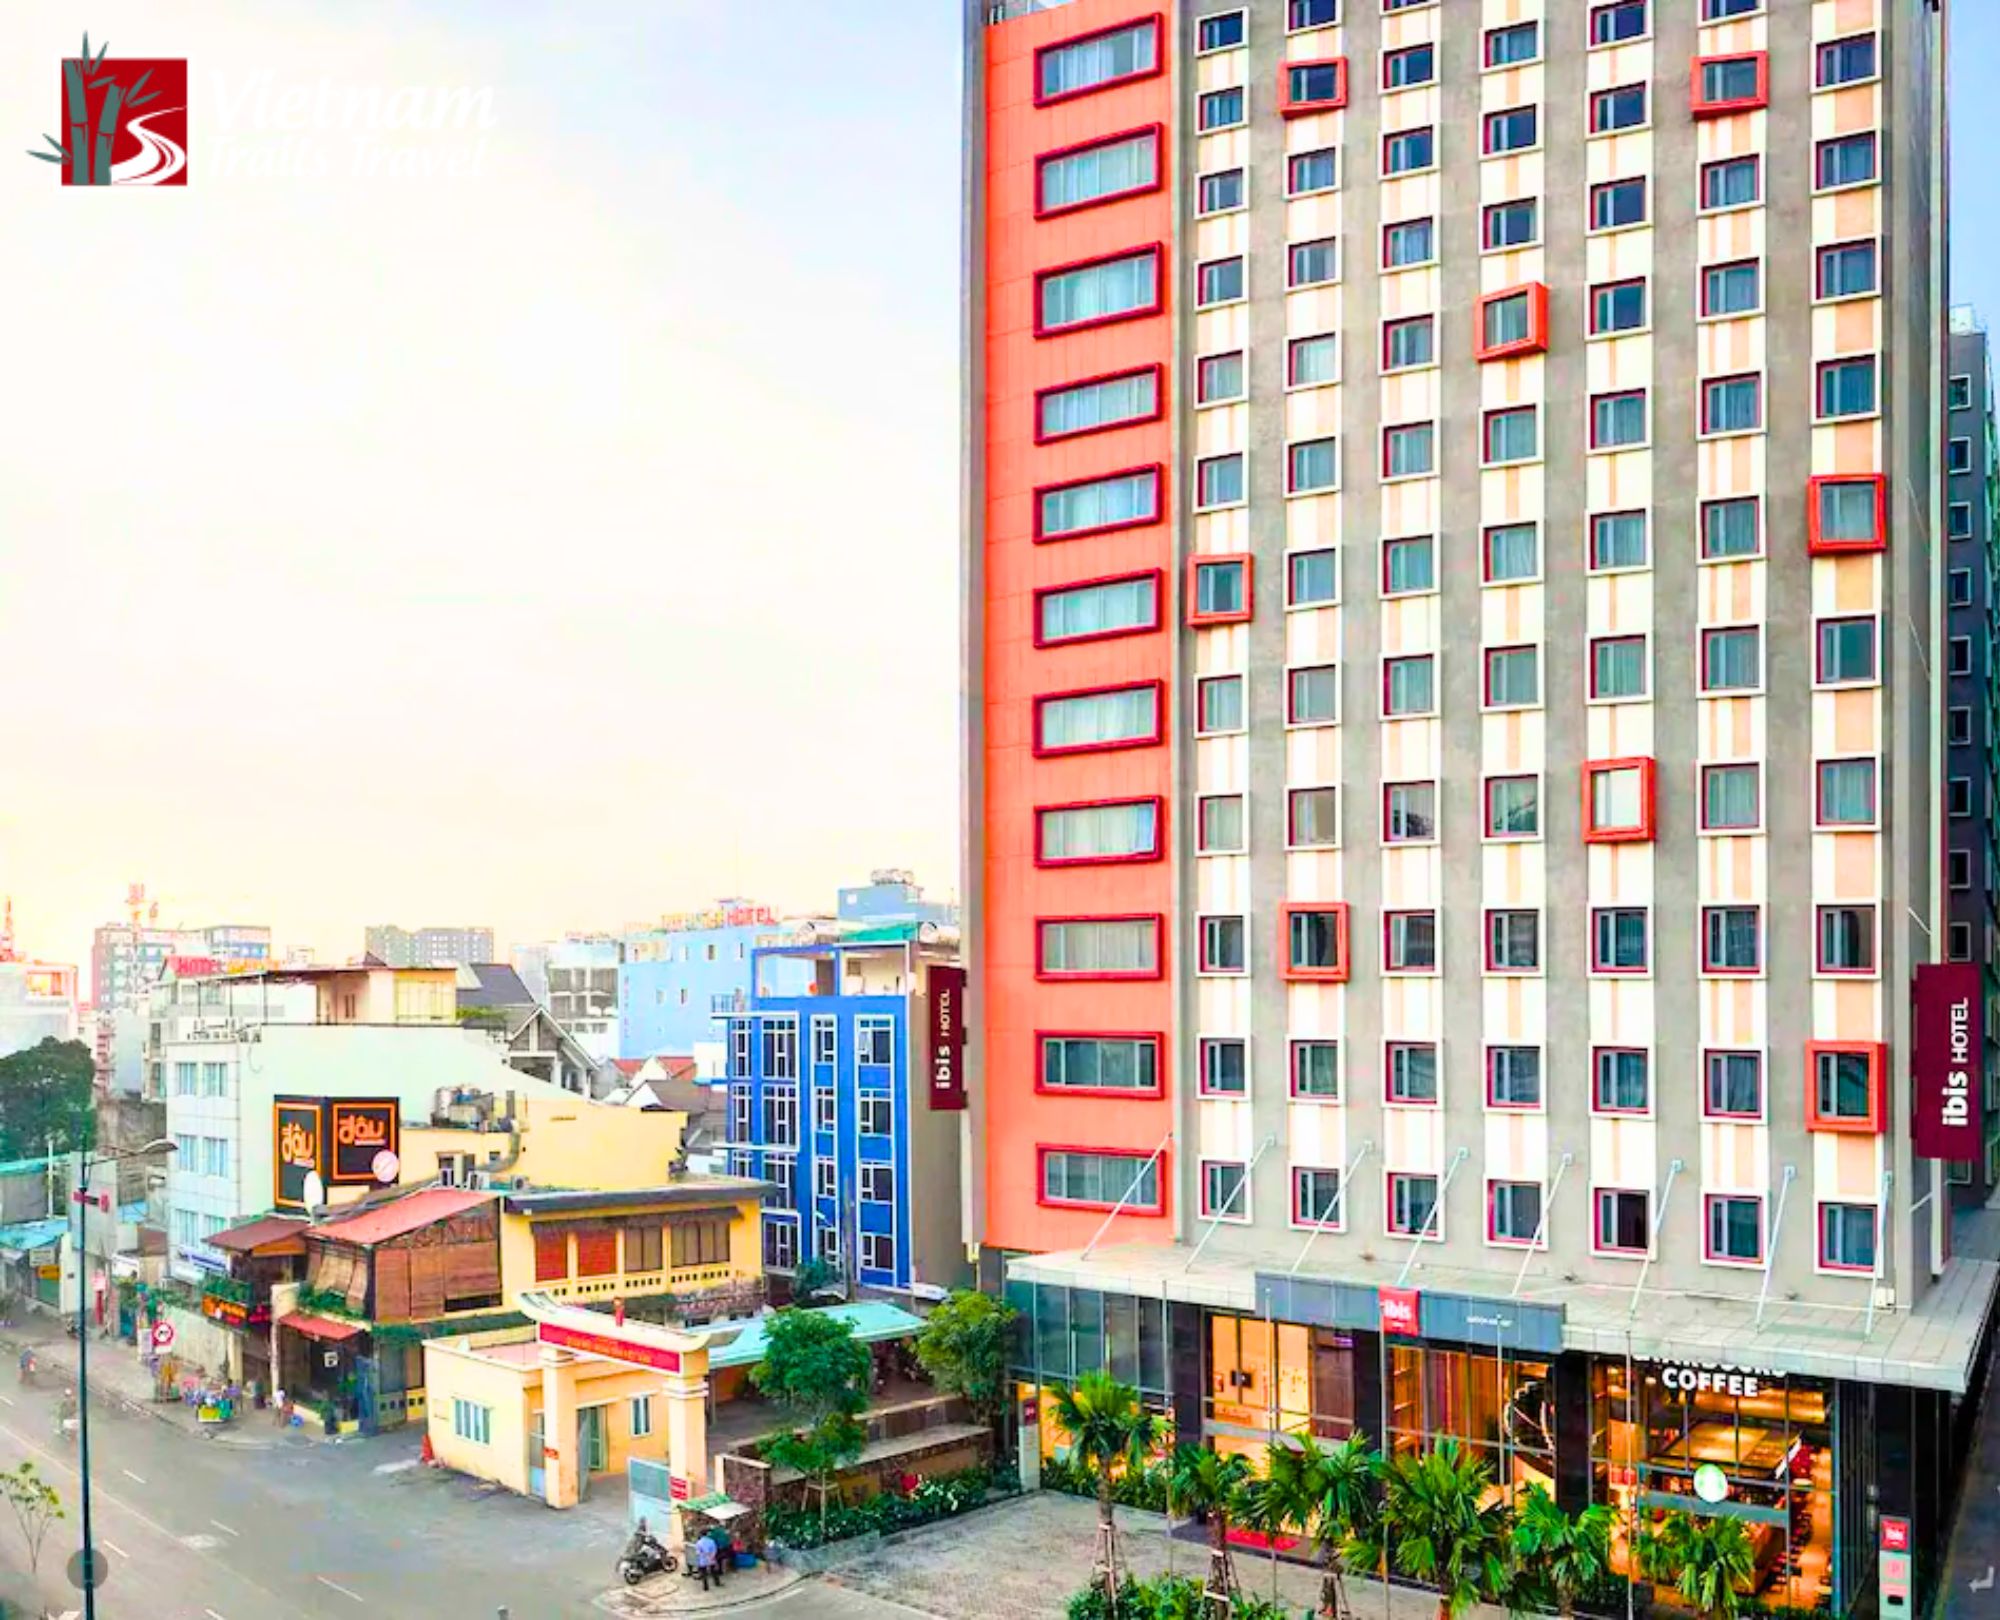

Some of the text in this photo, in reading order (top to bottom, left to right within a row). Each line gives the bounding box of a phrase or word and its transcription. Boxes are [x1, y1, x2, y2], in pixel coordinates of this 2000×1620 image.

[935, 988, 951, 1089] ibis HOTEL
[1942, 997, 1968, 1126] ibis HOTEL
[1662, 1367, 1758, 1397] COFFEE
